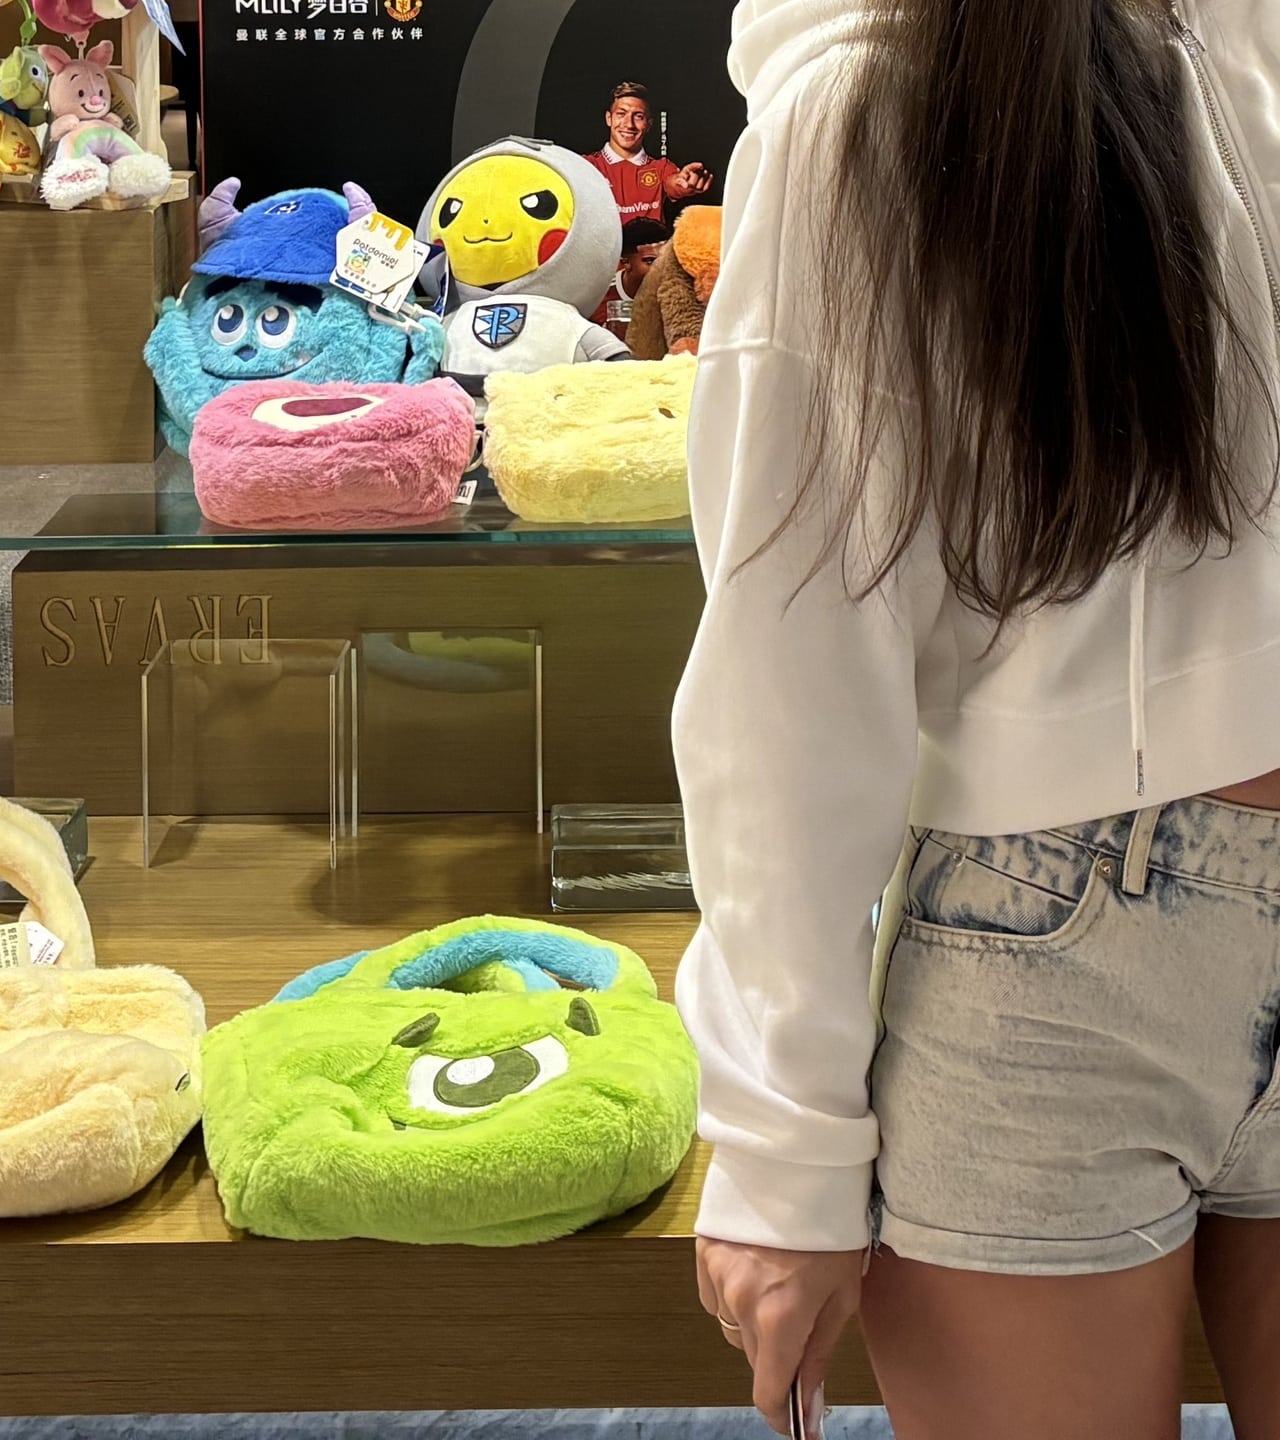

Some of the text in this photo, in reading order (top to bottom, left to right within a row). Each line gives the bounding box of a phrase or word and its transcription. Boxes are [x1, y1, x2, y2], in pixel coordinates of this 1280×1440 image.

[235, 28, 424, 41] 曼联全球官方合作伙伴
